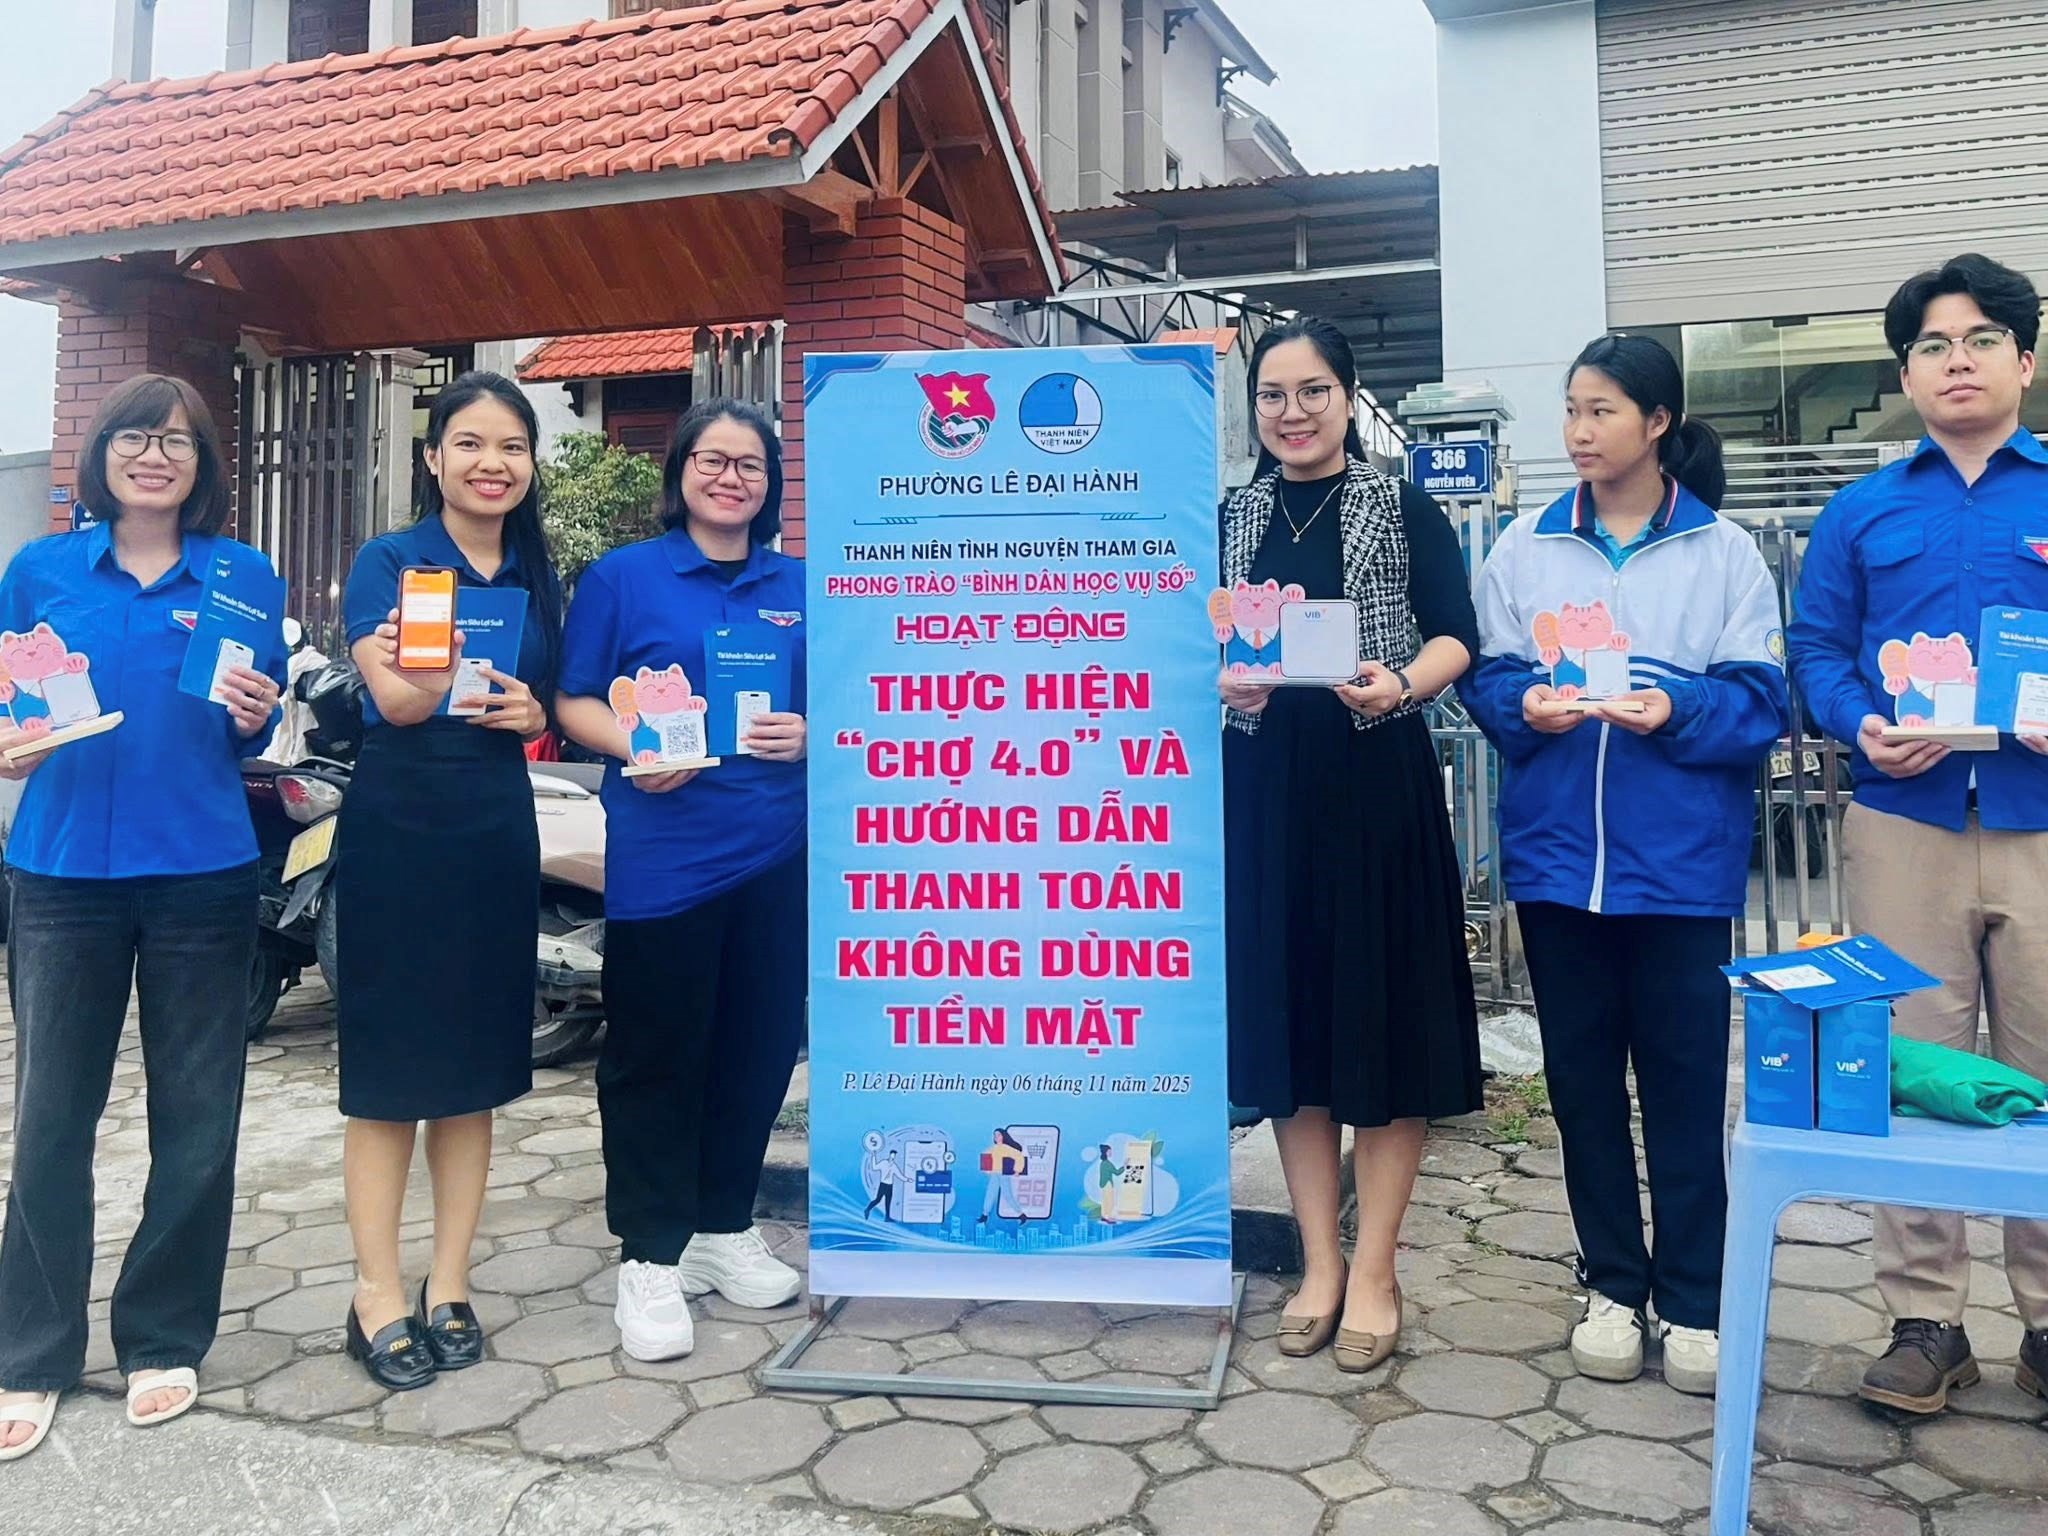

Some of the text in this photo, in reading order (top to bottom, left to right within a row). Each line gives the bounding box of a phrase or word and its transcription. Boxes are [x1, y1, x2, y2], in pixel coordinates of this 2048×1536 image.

[1040, 438, 1060, 447] VIỆT
[1068, 428, 1089, 437] NIÊN
[1431, 448, 1467, 470] 366
[880, 469, 1139, 498] PHƯỜNG LÊ ĐẠI HÀNH
[844, 538, 1177, 562] THANH NIÊN TÌNH NGUYỆN THAM GIA
[827, 576, 899, 595] PHONG
[905, 570, 956, 594] TRÀO
[1025, 568, 1067, 593] DÂN
[1073, 572, 1118, 598] HỌC
[1125, 571, 1152, 597] VỤ
[897, 606, 1126, 647] HOẠT ĐỘNG
[1304, 611, 1321, 619] VIB
[870, 665, 1151, 719] THỰC HIỆN
[1120, 730, 1190, 776] VÀ
[855, 789, 1170, 844] HƯỚNG DẪN
[844, 863, 1182, 910] THANH TOÁN
[838, 931, 1190, 979] KHÔNG DÙNG
[887, 994, 1142, 1055] TIỀN MẶT
[1761, 1056, 1783, 1067] VIB
[1836, 1061, 1858, 1073] VIB
[843, 1073, 1191, 1096] P. Lê Đại Hành ngày 06 tháng 11 năm 2025
